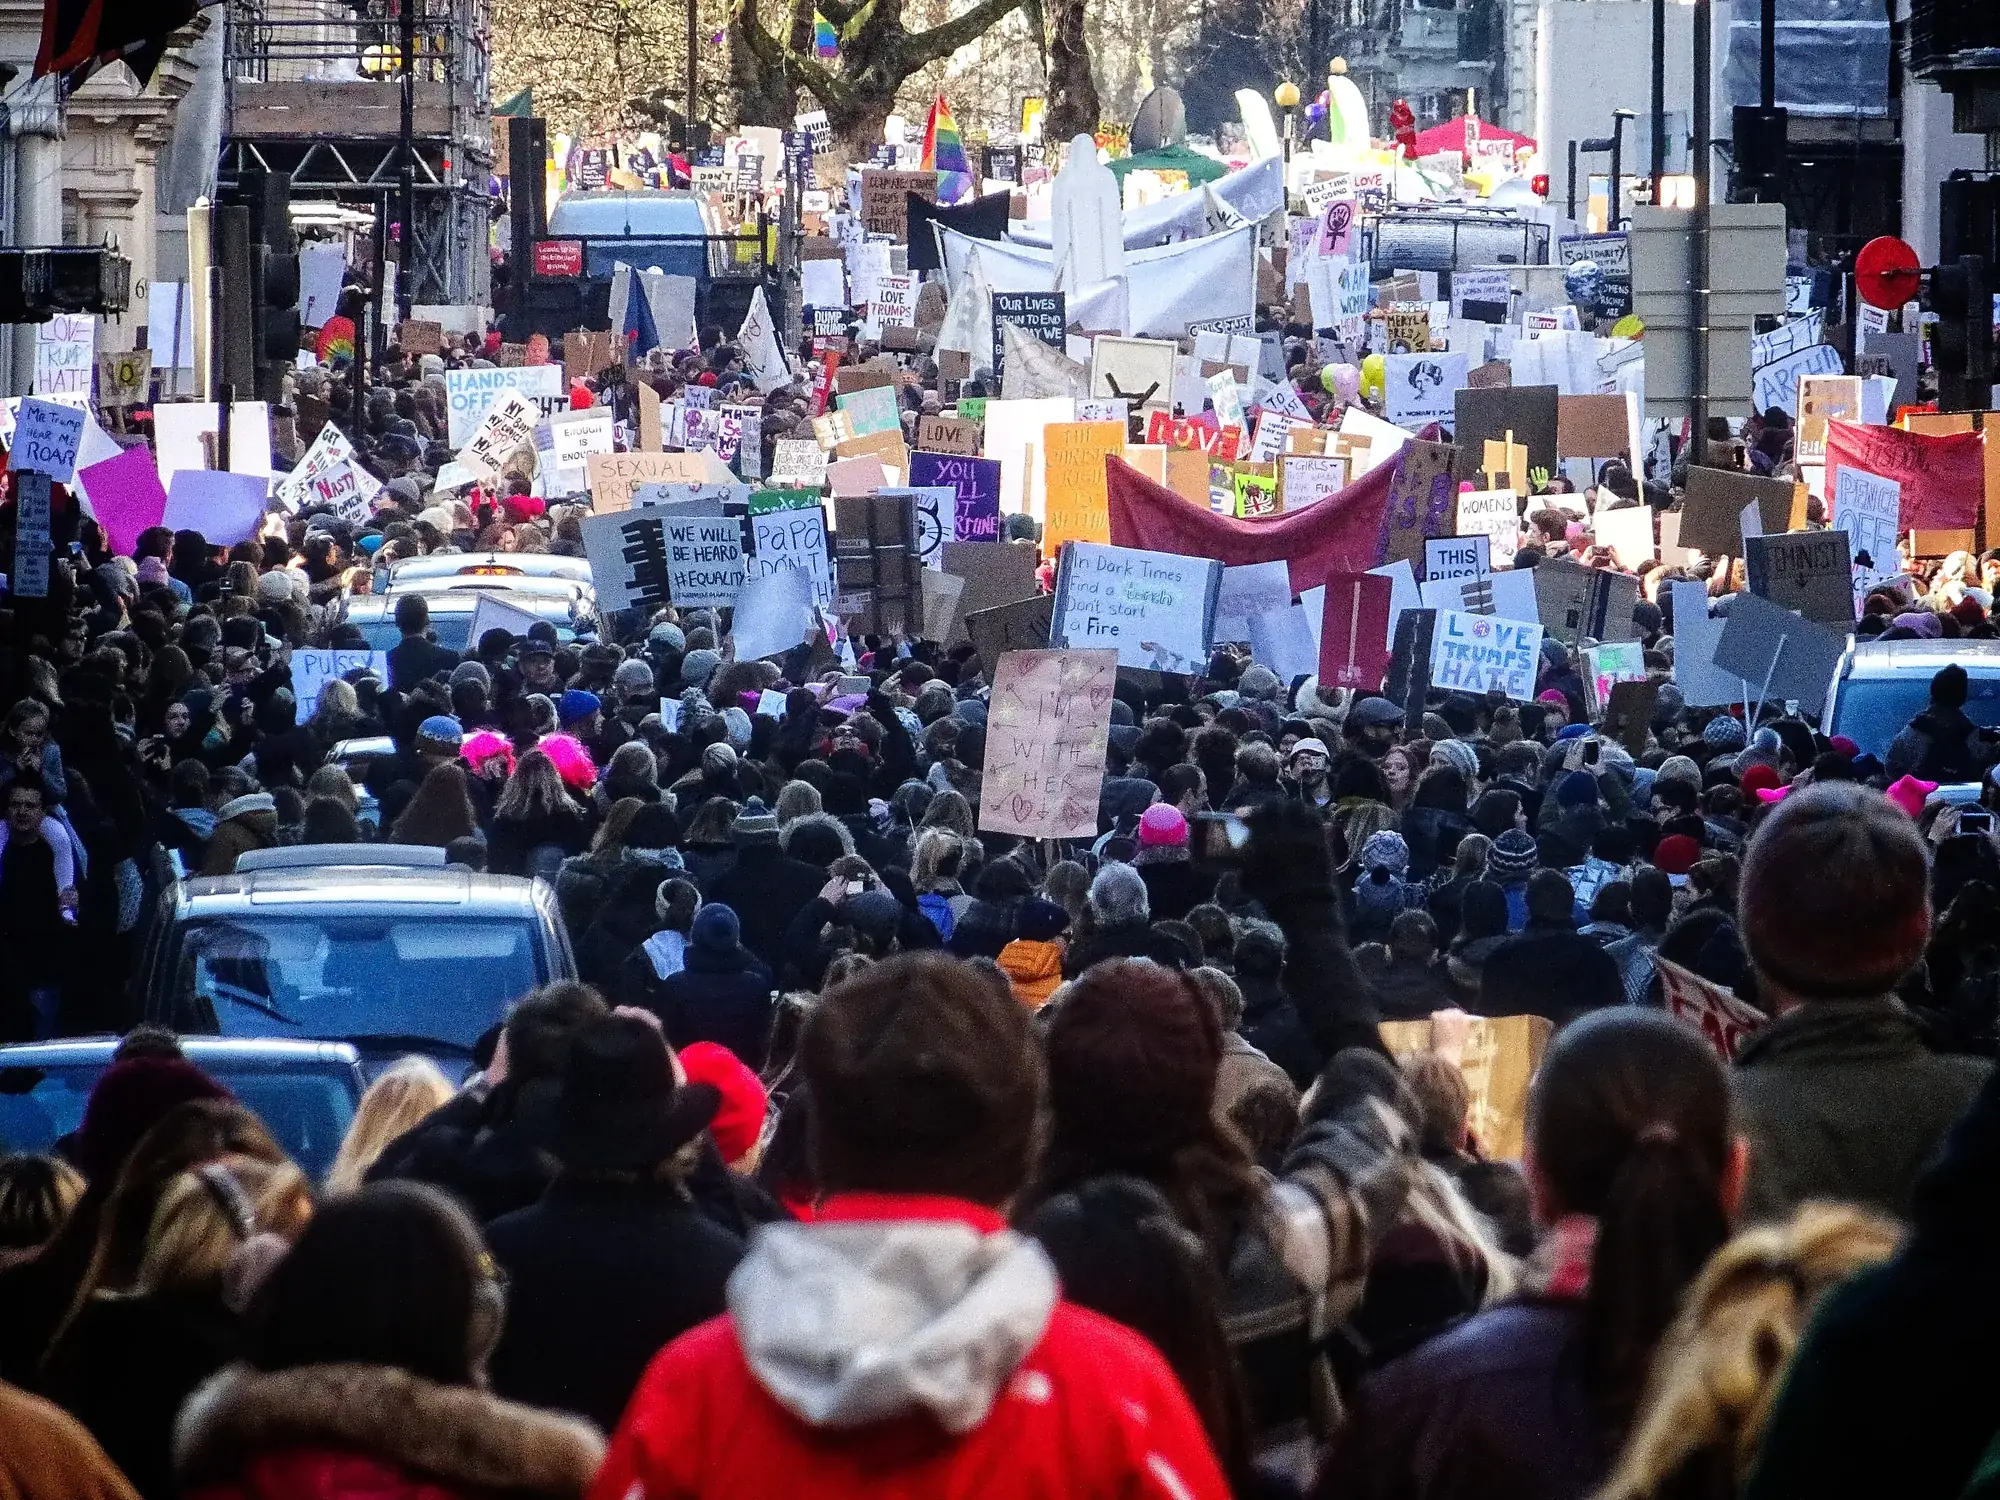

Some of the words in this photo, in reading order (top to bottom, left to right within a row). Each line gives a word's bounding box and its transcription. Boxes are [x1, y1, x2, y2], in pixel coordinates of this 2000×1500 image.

[1354, 174, 1382, 187] LOVE
[1564, 245, 1627, 264] SOLIDARITY
[880, 290, 905, 304] LOVE
[1000, 296, 1022, 310] OUR
[1025, 296, 1056, 310] LIVES
[814, 310, 842, 324] DUMP
[871, 303, 912, 317] TRUMPS
[1026, 314, 1039, 325] TO
[1040, 314, 1062, 325] END
[40, 316, 91, 343] LOVE
[815, 323, 848, 336] TRUMP
[1387, 313, 1420, 327] MERYL
[1043, 327, 1063, 339] WE
[449, 371, 518, 393] HANDS
[452, 391, 495, 411] OFF
[504, 399, 525, 416] MY
[49, 412, 81, 432] Trump
[488, 414, 501, 427] MY
[321, 429, 340, 450] GET
[579, 437, 588, 447] IS
[926, 423, 963, 443] LOVE
[1157, 423, 1237, 460] LOVE
[473, 436, 492, 452] MY
[27, 441, 76, 467] ROAR
[601, 459, 691, 479] SEXUAL
[936, 459, 975, 480] YOU
[1296, 460, 1330, 472] GIRLS
[316, 472, 356, 502] NASTY
[1461, 496, 1513, 514] WOMENS
[670, 526, 695, 542] WE
[700, 527, 738, 542] WILL
[1836, 508, 1896, 558] OFF
[672, 545, 690, 561] BE
[694, 545, 738, 563] HEARD
[1438, 549, 1476, 565] THIS
[1072, 550, 1091, 570] In
[1097, 556, 1134, 576] Dark
[1140, 559, 1183, 582] Times
[674, 570, 745, 589] #EQUALITY
[1070, 575, 1101, 594] Find
[1105, 585, 1115, 596] a
[1066, 597, 1101, 614] Don't
[1108, 602, 1146, 618] start
[1070, 619, 1081, 631] a
[1086, 616, 1120, 637] Fire
[1442, 640, 1532, 670] TRUMPS
[1440, 659, 1526, 695] HATE
[1013, 736, 1082, 764] WITH
[1023, 770, 1076, 793] HER
